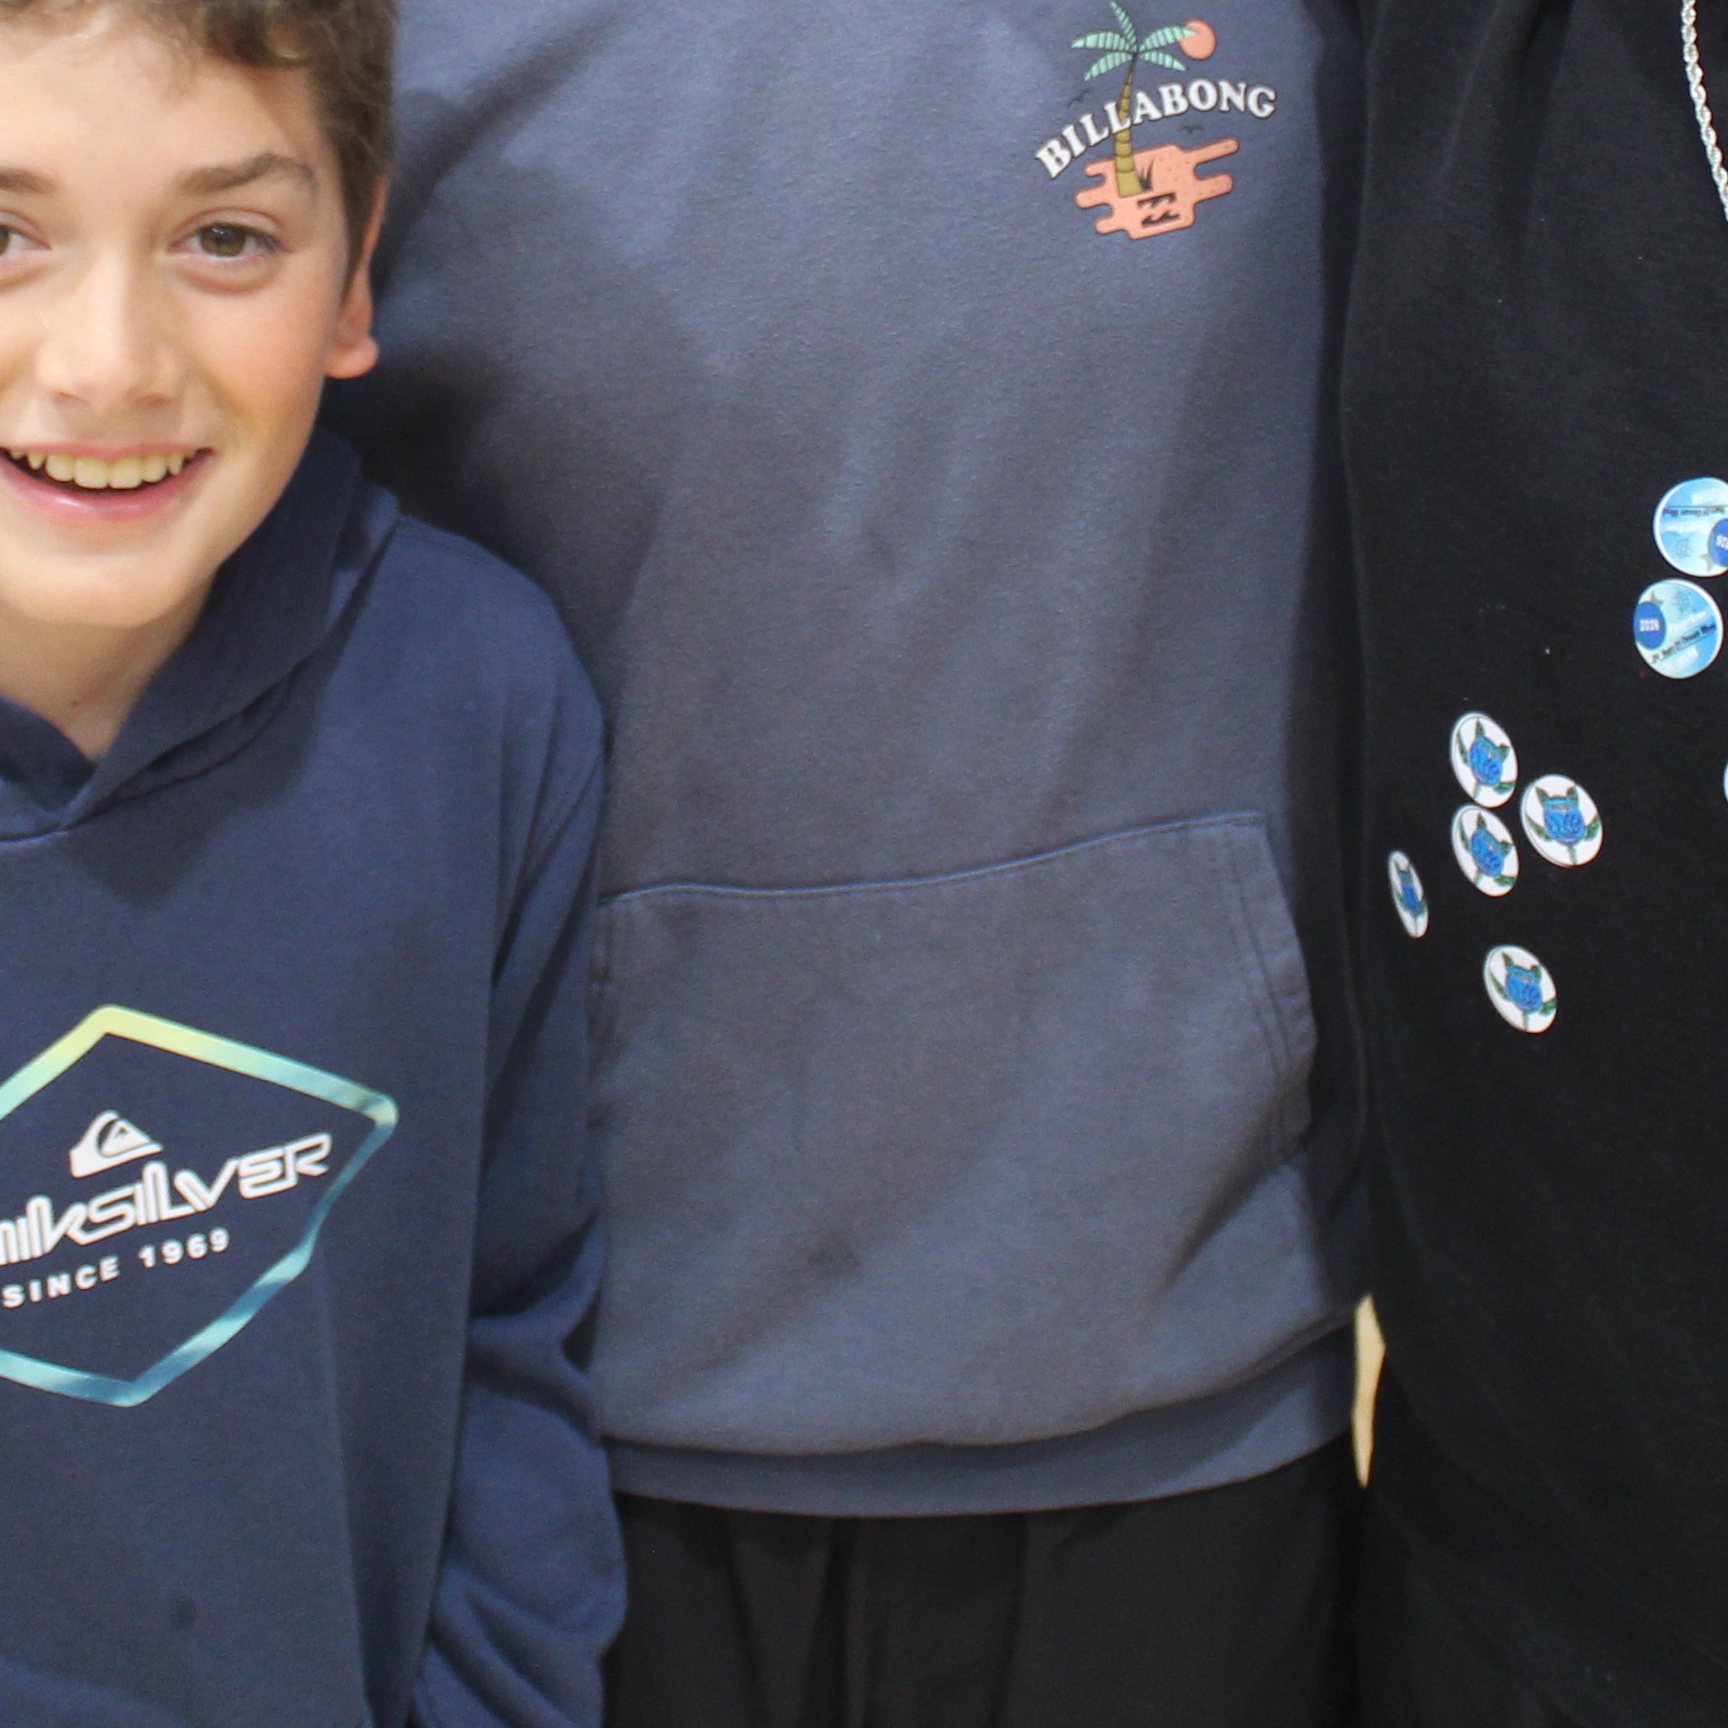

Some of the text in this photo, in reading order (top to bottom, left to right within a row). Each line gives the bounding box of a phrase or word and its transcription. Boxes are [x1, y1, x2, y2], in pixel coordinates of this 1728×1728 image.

[1034, 78, 1276, 179] BILLABONG
[1, 1228, 230, 1308] SINCE 1969
